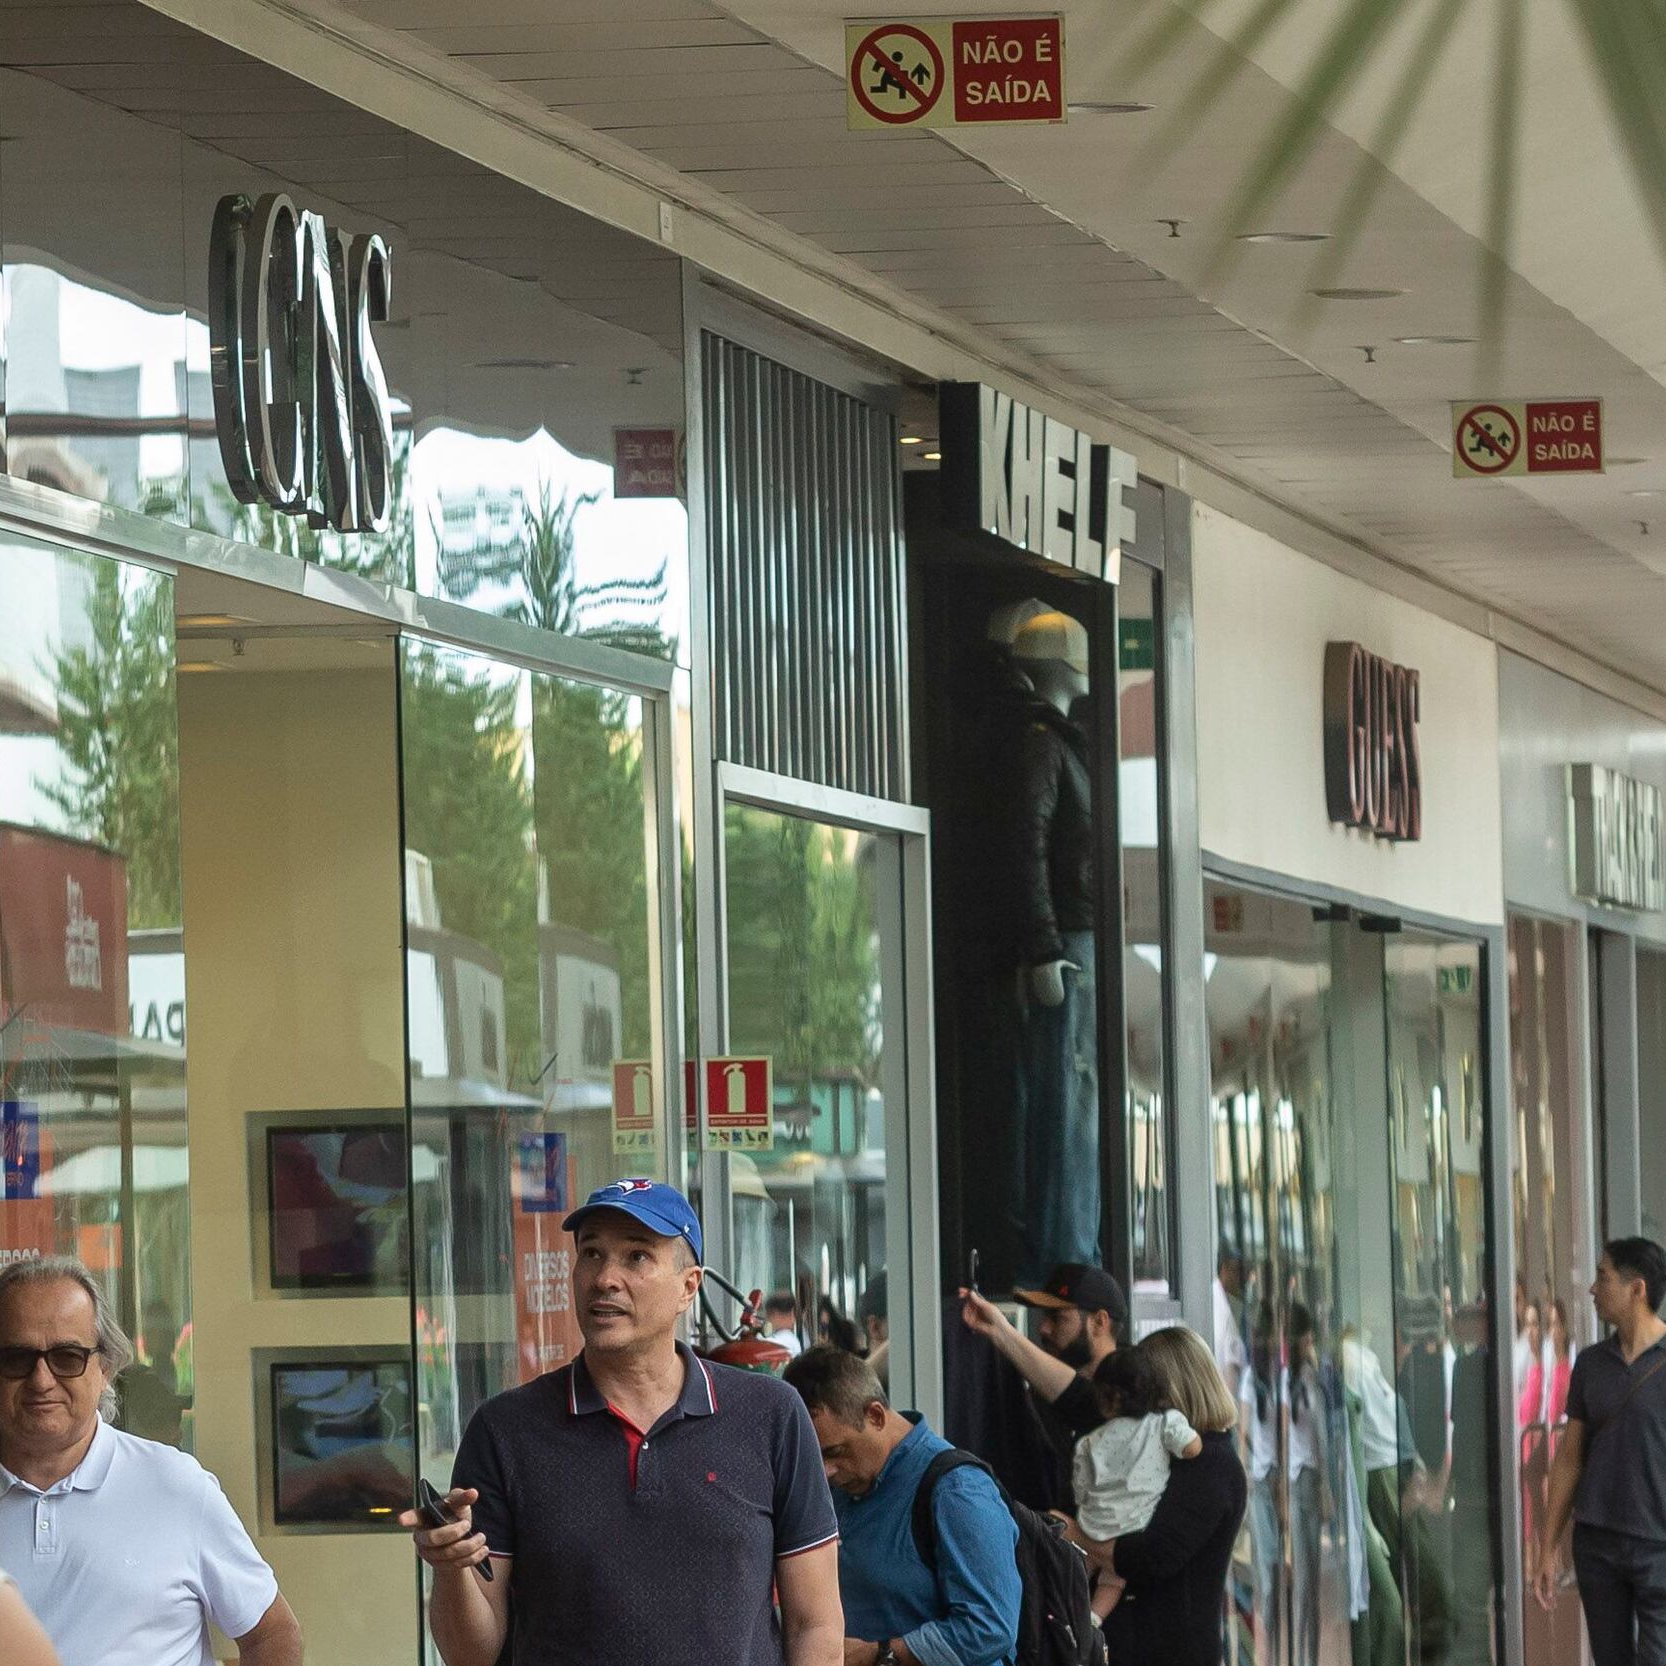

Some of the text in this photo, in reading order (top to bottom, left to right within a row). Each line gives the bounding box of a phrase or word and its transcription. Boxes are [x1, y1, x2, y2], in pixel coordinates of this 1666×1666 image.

[962, 33, 1053, 65] NÃO É
[965, 74, 1052, 105] SAÍDA
[1533, 409, 1595, 433] NÃO É
[1535, 439, 1595, 461] SAÍDA
[973, 382, 1139, 586] KHELF
[1335, 641, 1422, 841] GUESS
